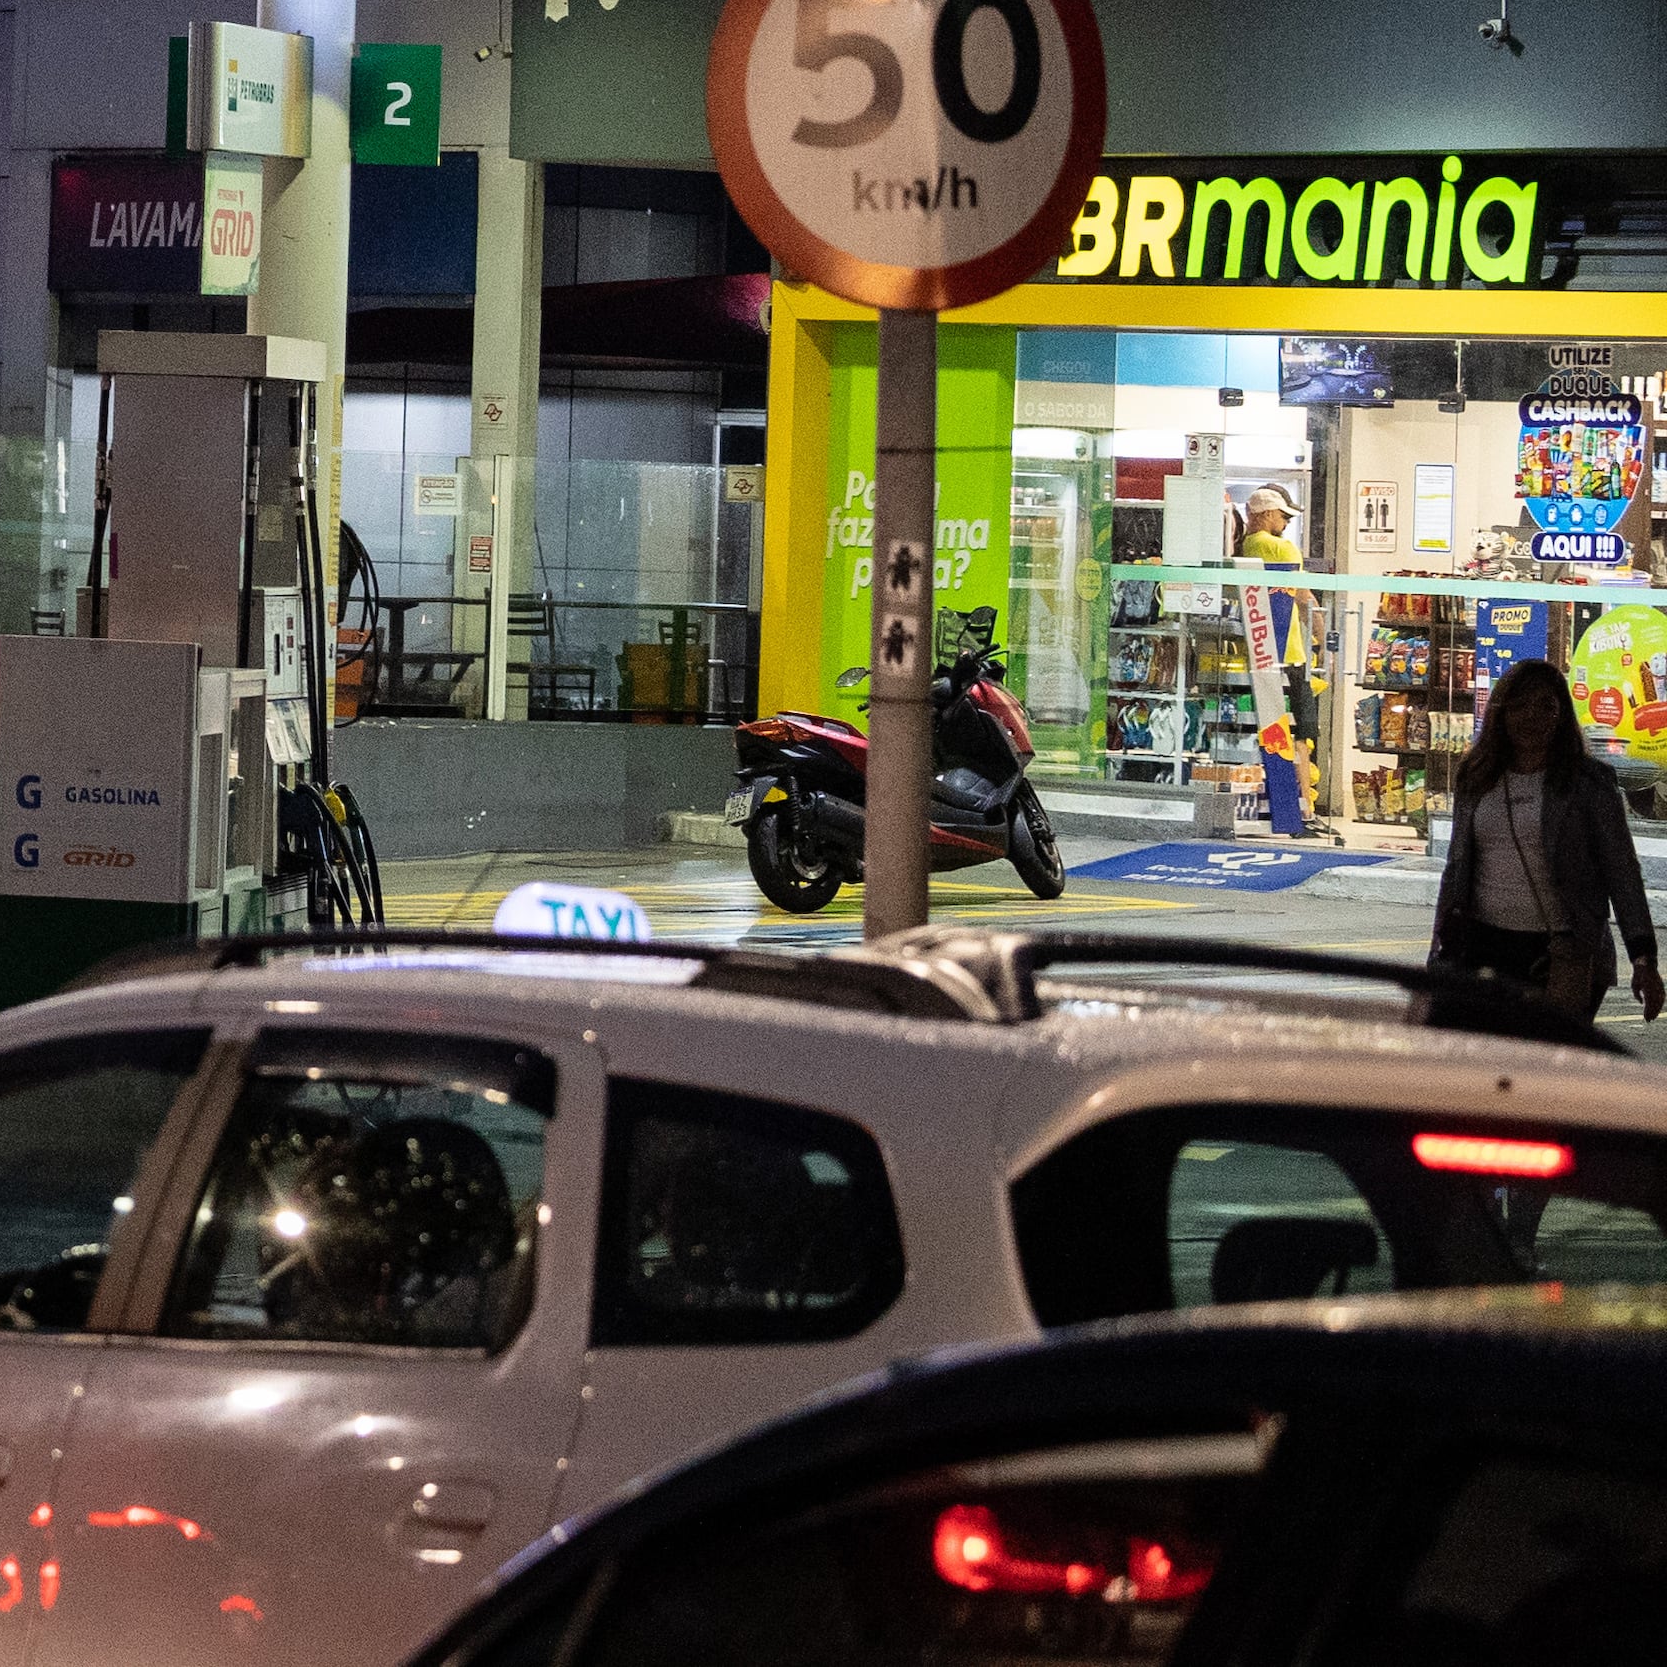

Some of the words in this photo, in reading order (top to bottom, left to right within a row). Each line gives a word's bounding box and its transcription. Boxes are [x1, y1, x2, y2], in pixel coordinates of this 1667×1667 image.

[240, 80, 275, 104] PETROBRAS
[384, 82, 413, 126] 2
[851, 168, 980, 216] km/h
[210, 209, 254, 257] GRID
[1057, 155, 1539, 283] BRmania
[1550, 347, 1611, 366] UTILIZE
[1573, 367, 1589, 376] SEU
[1550, 376, 1611, 397] DUQUE
[1528, 400, 1632, 422] CASHBACK
[1369, 486, 1395, 497] AVISO
[826, 506, 875, 559] faz
[935, 518, 989, 549] ma
[1539, 535, 1592, 560] AQUI
[1491, 608, 1529, 623] PROMO
[1250, 624, 1274, 670] Bull
[16, 775, 41, 809] G
[65, 786, 161, 806] GASOLINA
[14, 834, 40, 867] G
[63, 847, 136, 868] GRID
